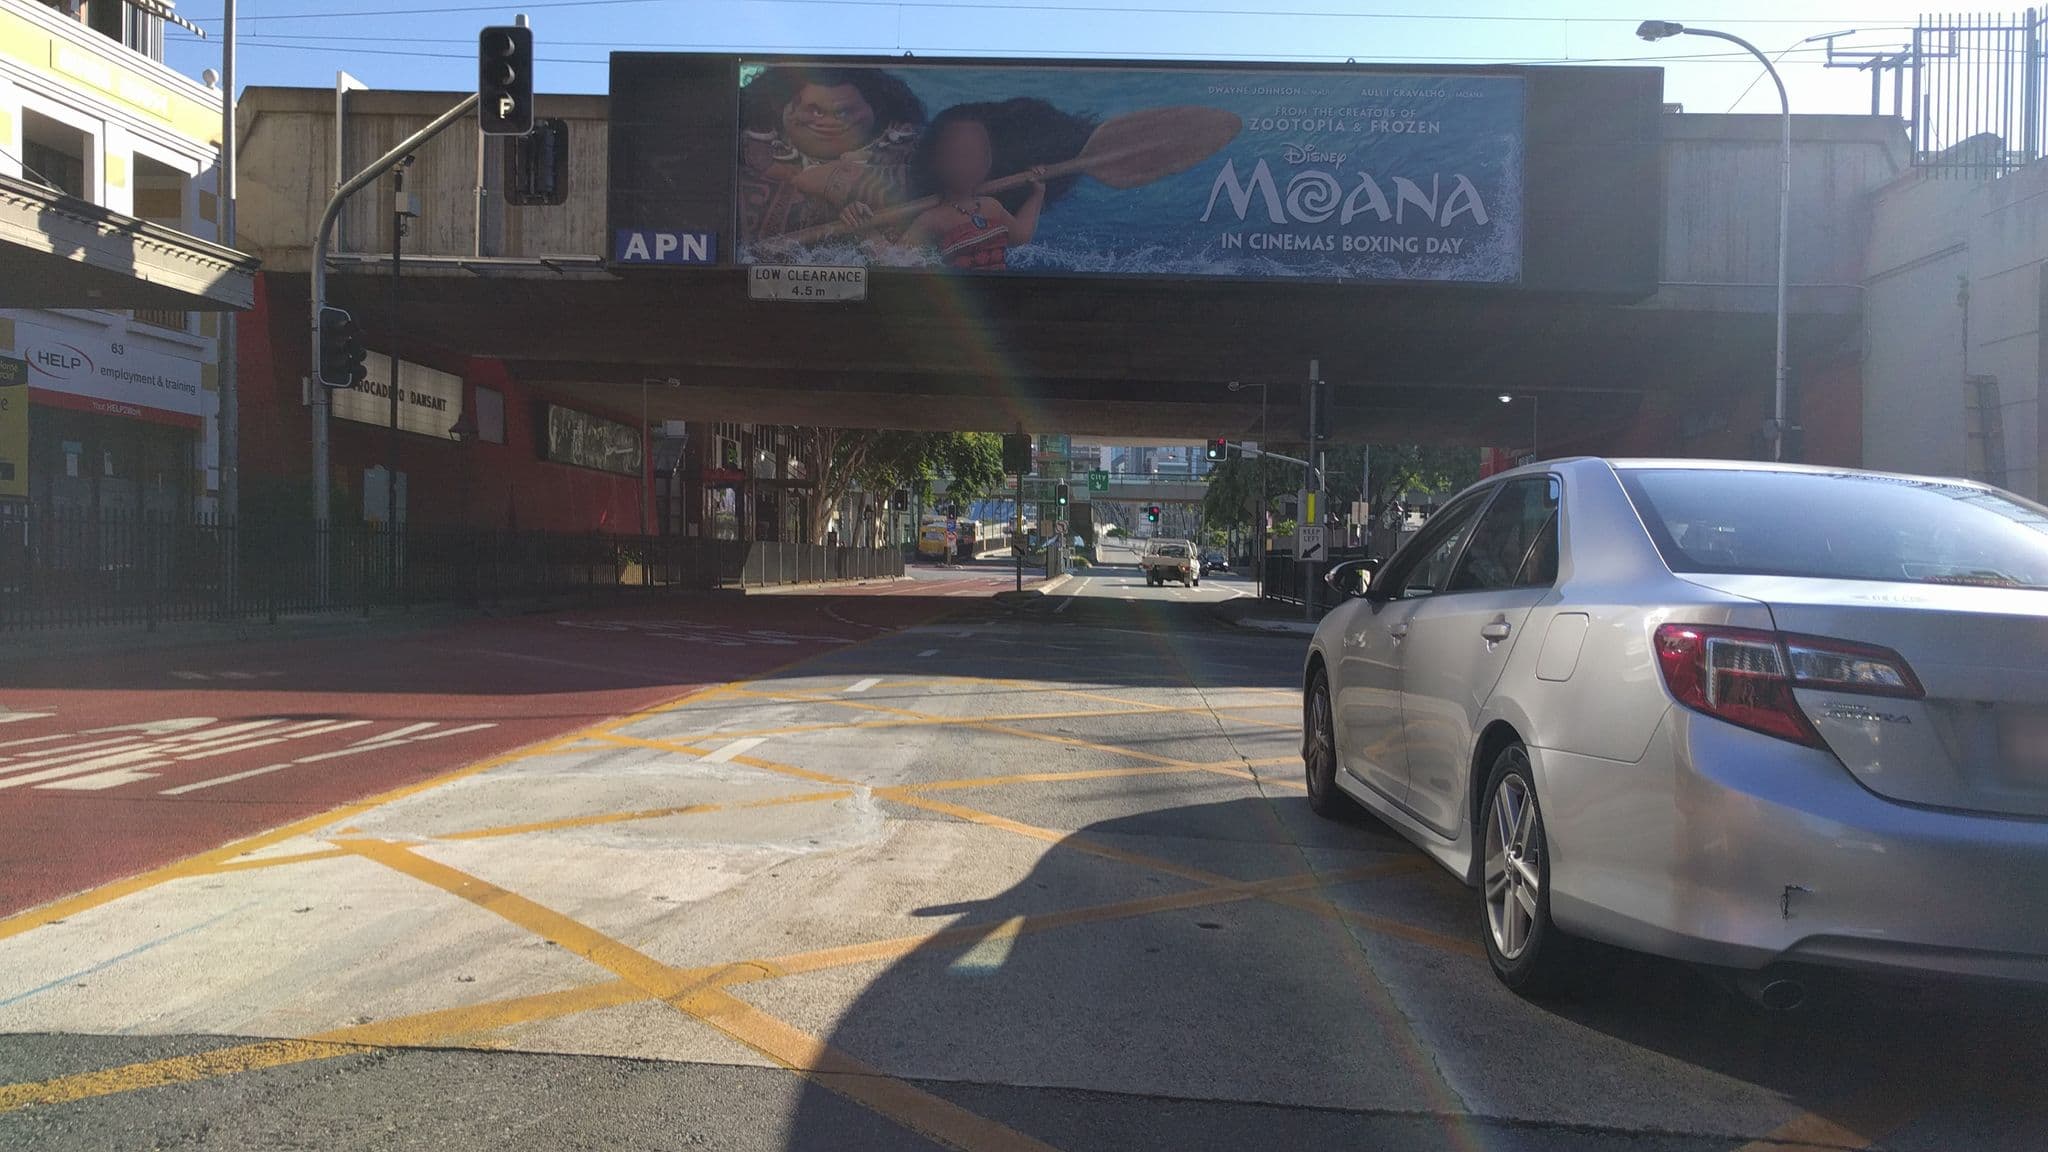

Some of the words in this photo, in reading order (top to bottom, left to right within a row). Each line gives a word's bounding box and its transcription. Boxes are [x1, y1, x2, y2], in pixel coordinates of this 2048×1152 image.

[1208, 86, 1249, 95] DWAYNE
[1252, 87, 1301, 96] JOHNSON
[1393, 89, 1446, 98] CRAVALHO
[1275, 107, 1308, 117] FROM
[1313, 107, 1334, 117] THE
[1338, 108, 1396, 118] CREATORS
[1400, 109, 1417, 118] OF
[1248, 118, 1345, 133] ZOOTOPIA
[1352, 121, 1362, 133] &
[1371, 120, 1440, 134] FROZEN
[1200, 157, 1489, 227] MOANA
[623, 232, 708, 261] APN
[1221, 233, 1242, 249] IN
[1248, 233, 1335, 251] CINEMAS
[1342, 235, 1418, 253] BOXING
[1426, 237, 1464, 254] DAY
[755, 268, 781, 280] LOW
[787, 269, 862, 282] CLEARANCE
[791, 285, 813, 296] 4.5
[815, 288, 826, 296] m
[111, 343, 124, 355] 63
[37, 351, 81, 369] HELP
[100, 367, 157, 387] employment
[157, 376, 166, 388] &
[165, 377, 196, 396] training
[411, 391, 447, 412] DANSANT
[1090, 473, 1107, 482] City
